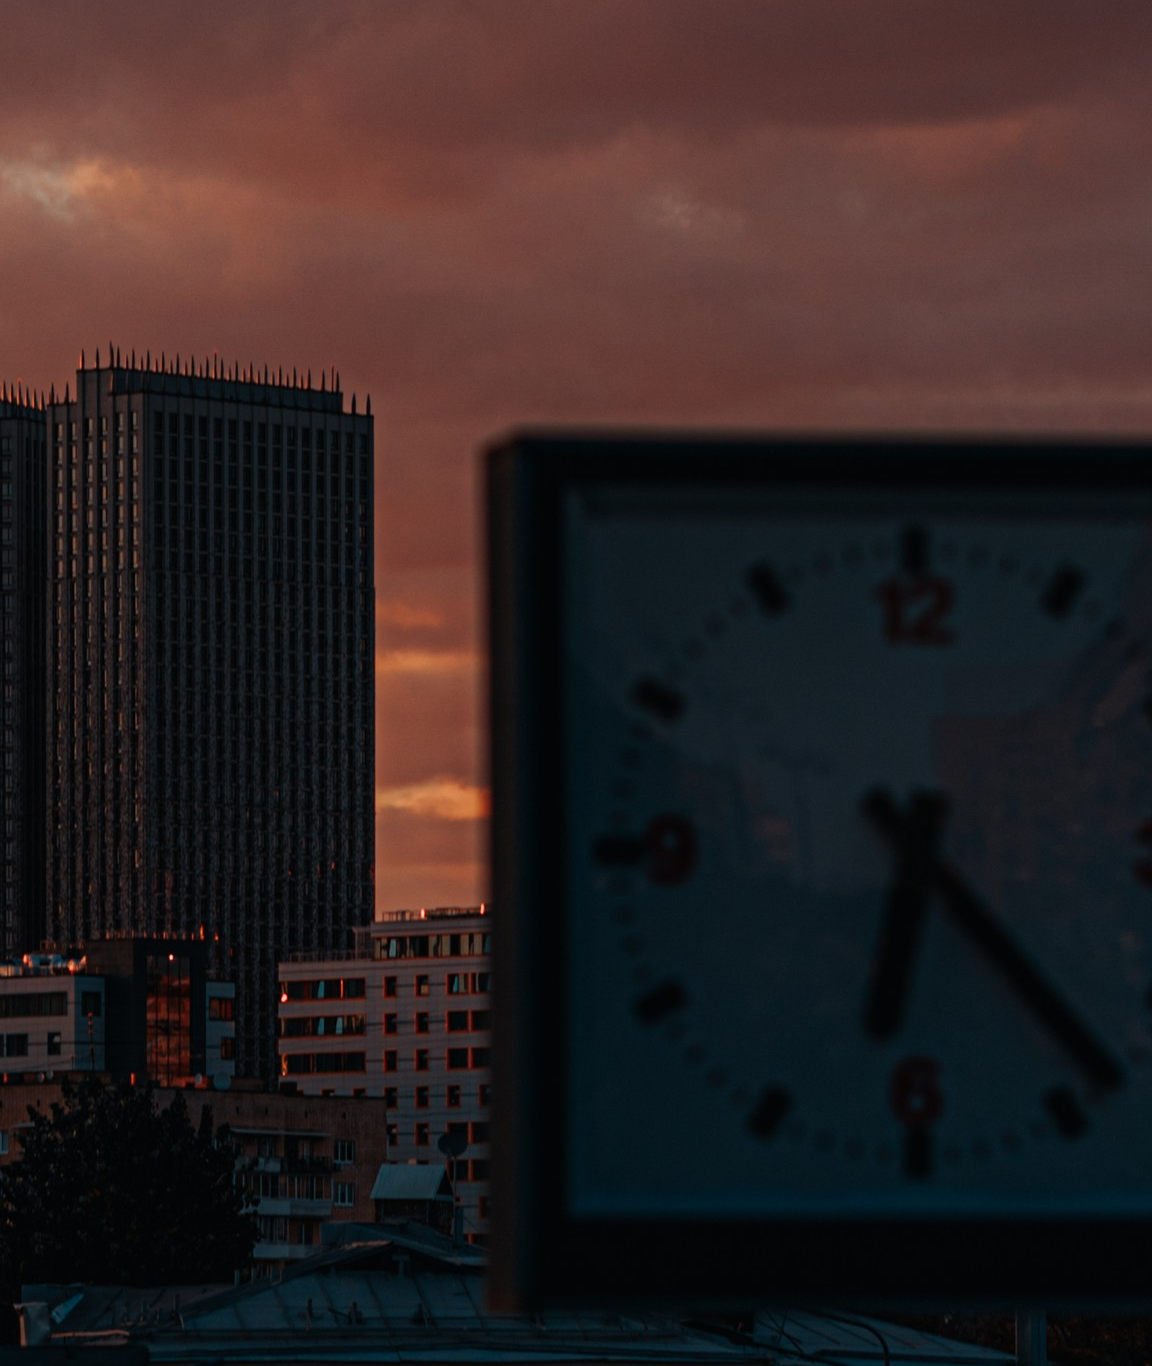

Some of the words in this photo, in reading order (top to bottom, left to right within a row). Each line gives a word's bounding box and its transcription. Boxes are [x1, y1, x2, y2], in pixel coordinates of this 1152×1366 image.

[878, 575, 956, 647] 12
[644, 813, 696, 887] 9
[890, 1056, 944, 1125] 6
